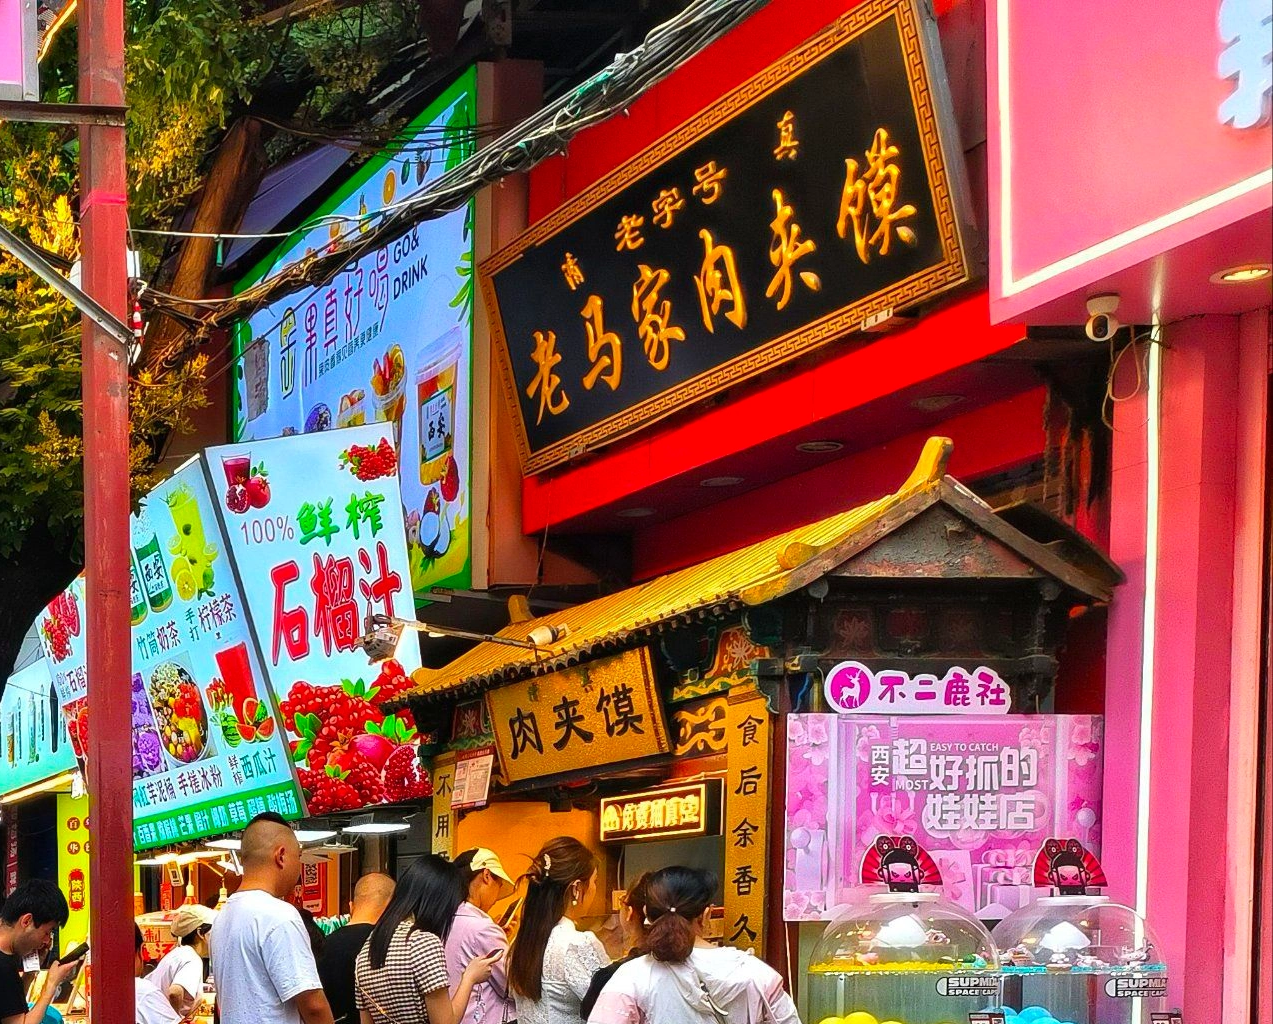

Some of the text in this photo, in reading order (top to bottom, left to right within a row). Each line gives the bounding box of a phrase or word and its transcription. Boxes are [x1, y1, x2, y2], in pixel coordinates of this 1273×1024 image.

[614, 160, 726, 252] 老字号
[773, 110, 799, 162] 真
[393, 254, 428, 301] DRINK
[526, 127, 917, 426] 老马家肉夹馍
[428, 409, 446, 441] 西安
[241, 491, 386, 546] 100% 鲜榨
[198, 593, 236, 632] 柠檬茶
[271, 541, 402, 666] 石榴汁
[136, 620, 181, 660] 竹筒奶茶
[66, 665, 87, 692] 石榴
[878, 672, 1007, 707] 不二鹿社
[510, 682, 644, 760] 肉夹馍
[240, 747, 277, 781] 西瓜汁
[871, 745, 890, 786] 西安
[930, 743, 999, 751] EASY TO CATCH
[177, 764, 224, 797] 手搓冰粉
[895, 780, 928, 790] MOST
[229, 801, 247, 824] 草莓
[730, 714, 764, 942] 食后余香久
[926, 793, 1036, 830] 娃娃店
